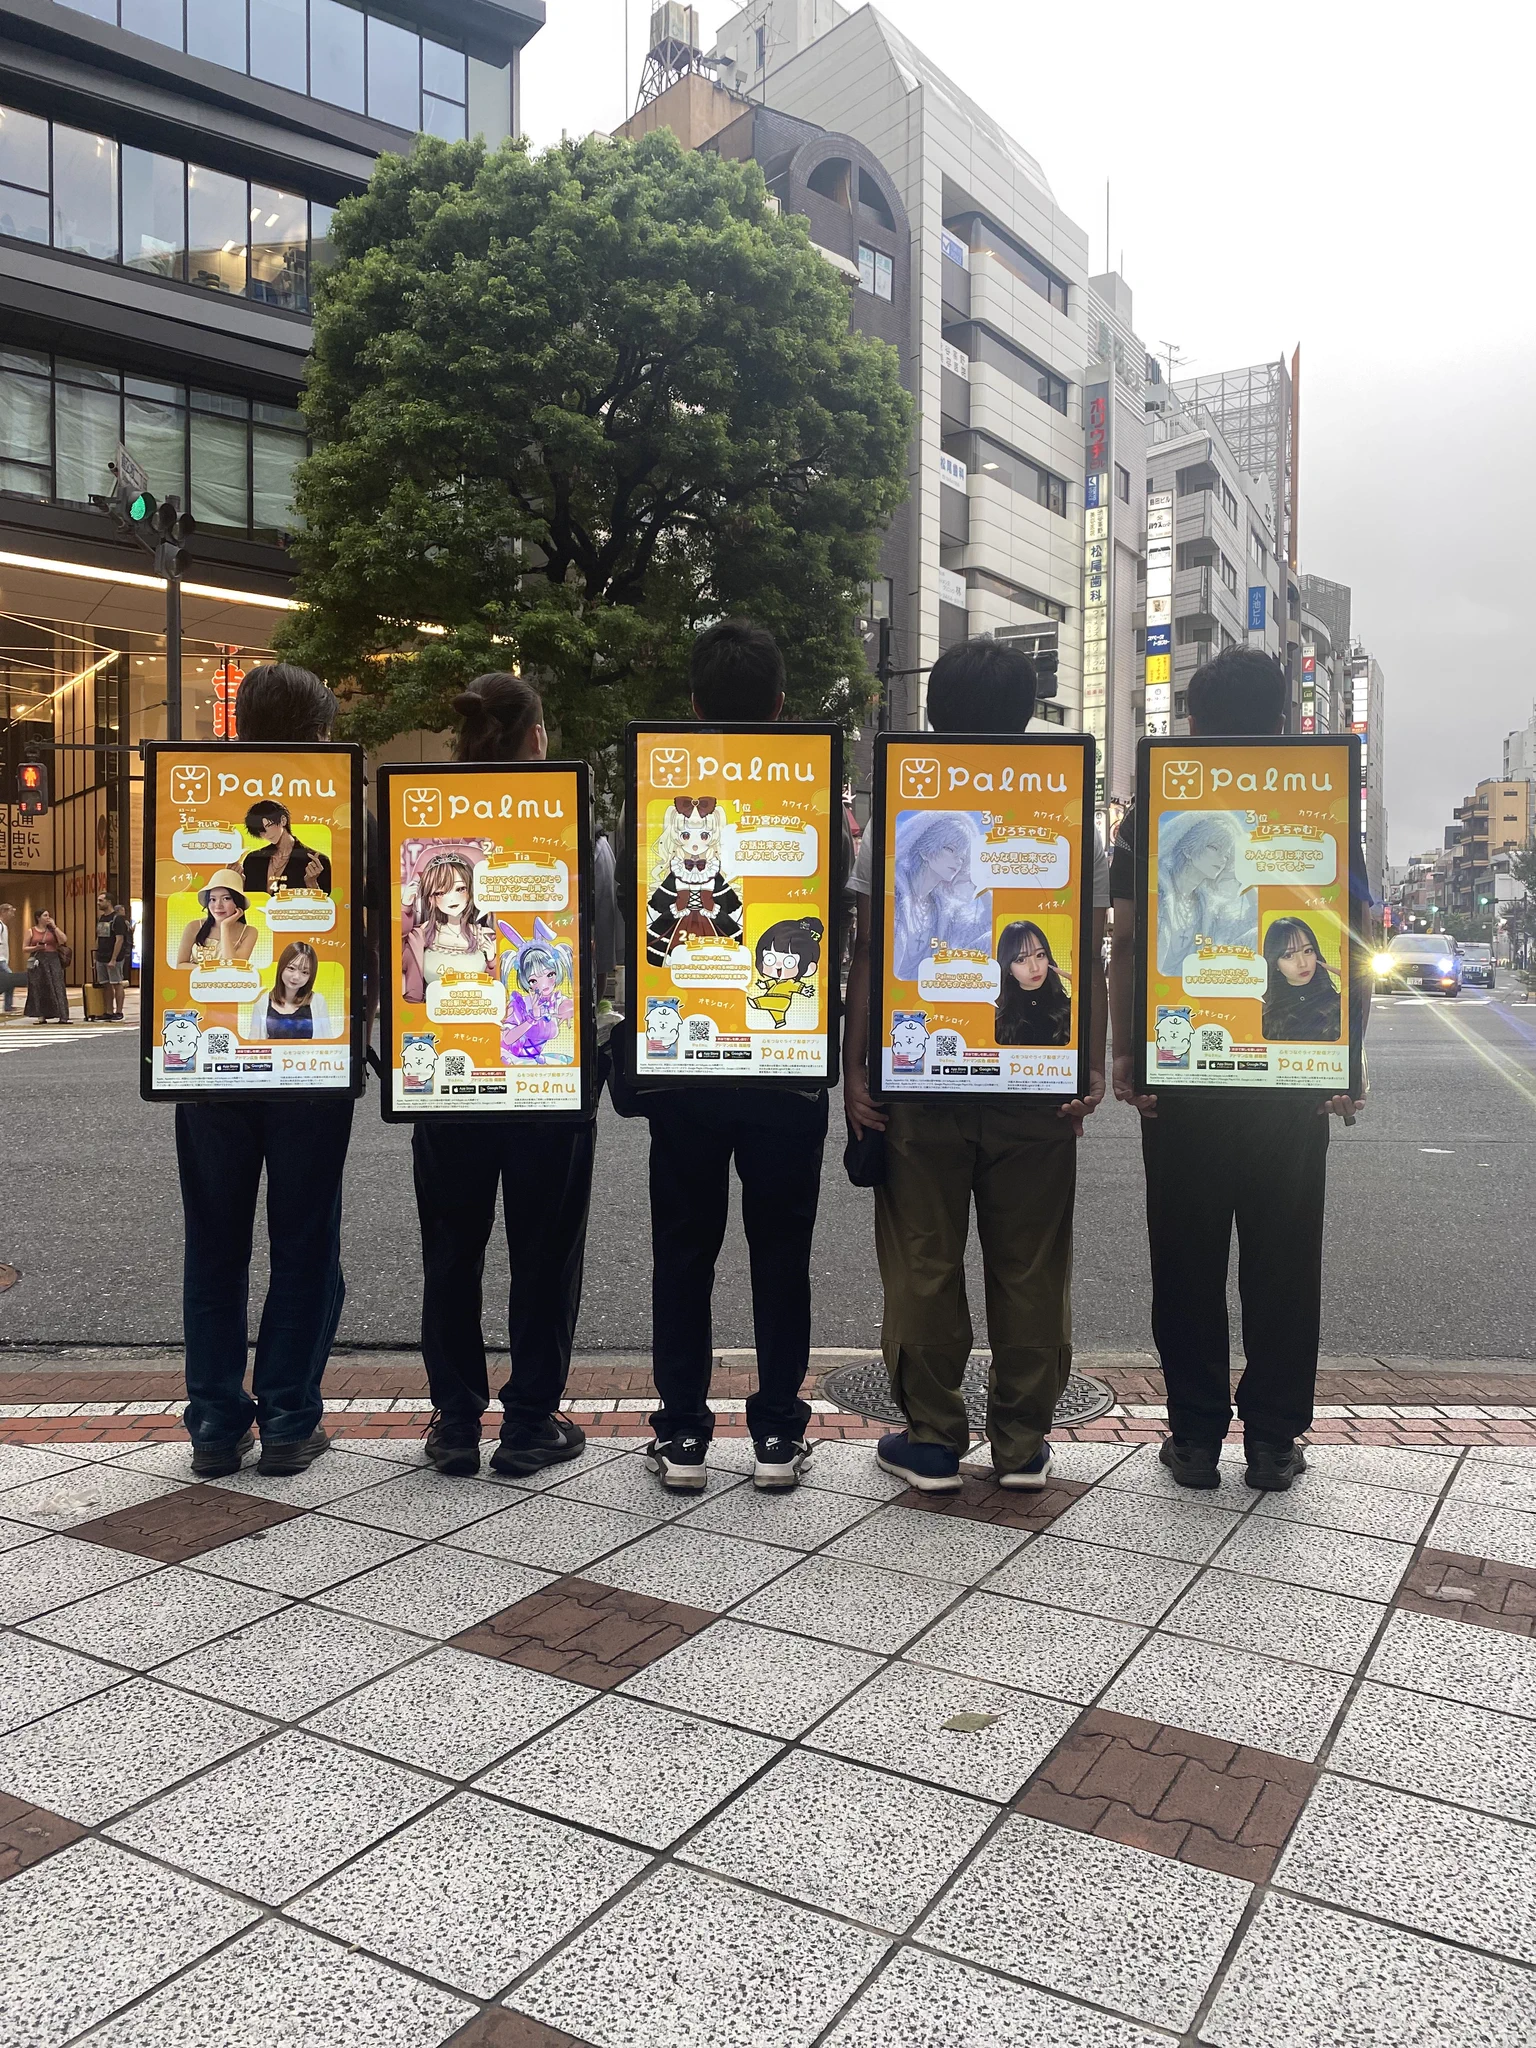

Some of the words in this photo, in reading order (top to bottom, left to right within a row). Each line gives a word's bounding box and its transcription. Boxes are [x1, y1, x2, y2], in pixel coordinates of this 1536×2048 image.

[1090, 545, 1102, 602] 松尾歯科
[1252, 591, 1261, 626] 小池ビル
[732, 799, 751, 813] 1位
[981, 811, 1003, 824] 3位
[1245, 810, 1267, 823] 3位
[197, 820, 220, 828] れいや
[1261, 825, 1313, 834] ひろちゃむ
[997, 827, 1047, 836] ひろちゃむ
[740, 840, 800, 850] お話出来ること
[514, 852, 530, 861] Tia
[735, 850, 804, 861] 楽しみにしてます
[980, 852, 1057, 863] みんな見に来てね
[1245, 850, 1323, 860] みんな見に来てね
[991, 864, 1048, 875] まってるよー
[1256, 861, 1315, 872] まってるよー
